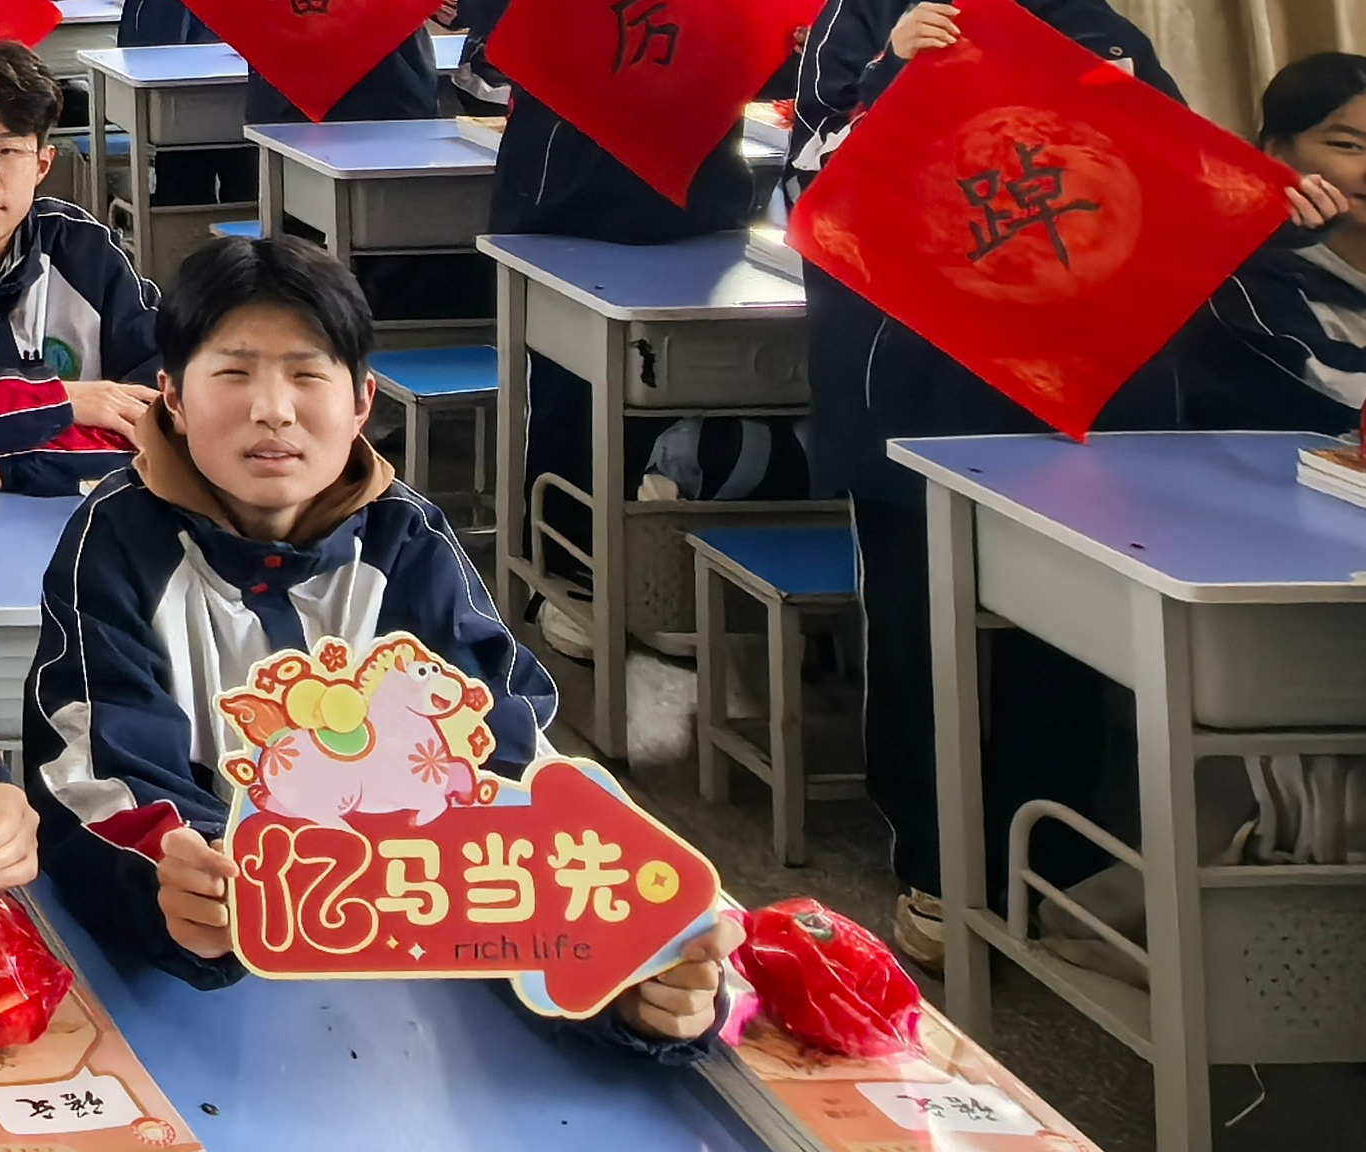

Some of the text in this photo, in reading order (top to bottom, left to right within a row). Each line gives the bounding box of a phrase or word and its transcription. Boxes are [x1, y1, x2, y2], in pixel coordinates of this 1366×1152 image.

[956, 141, 1102, 273] 踔
[241, 823, 632, 955] 亿马当先
[454, 934, 593, 961] rich life
